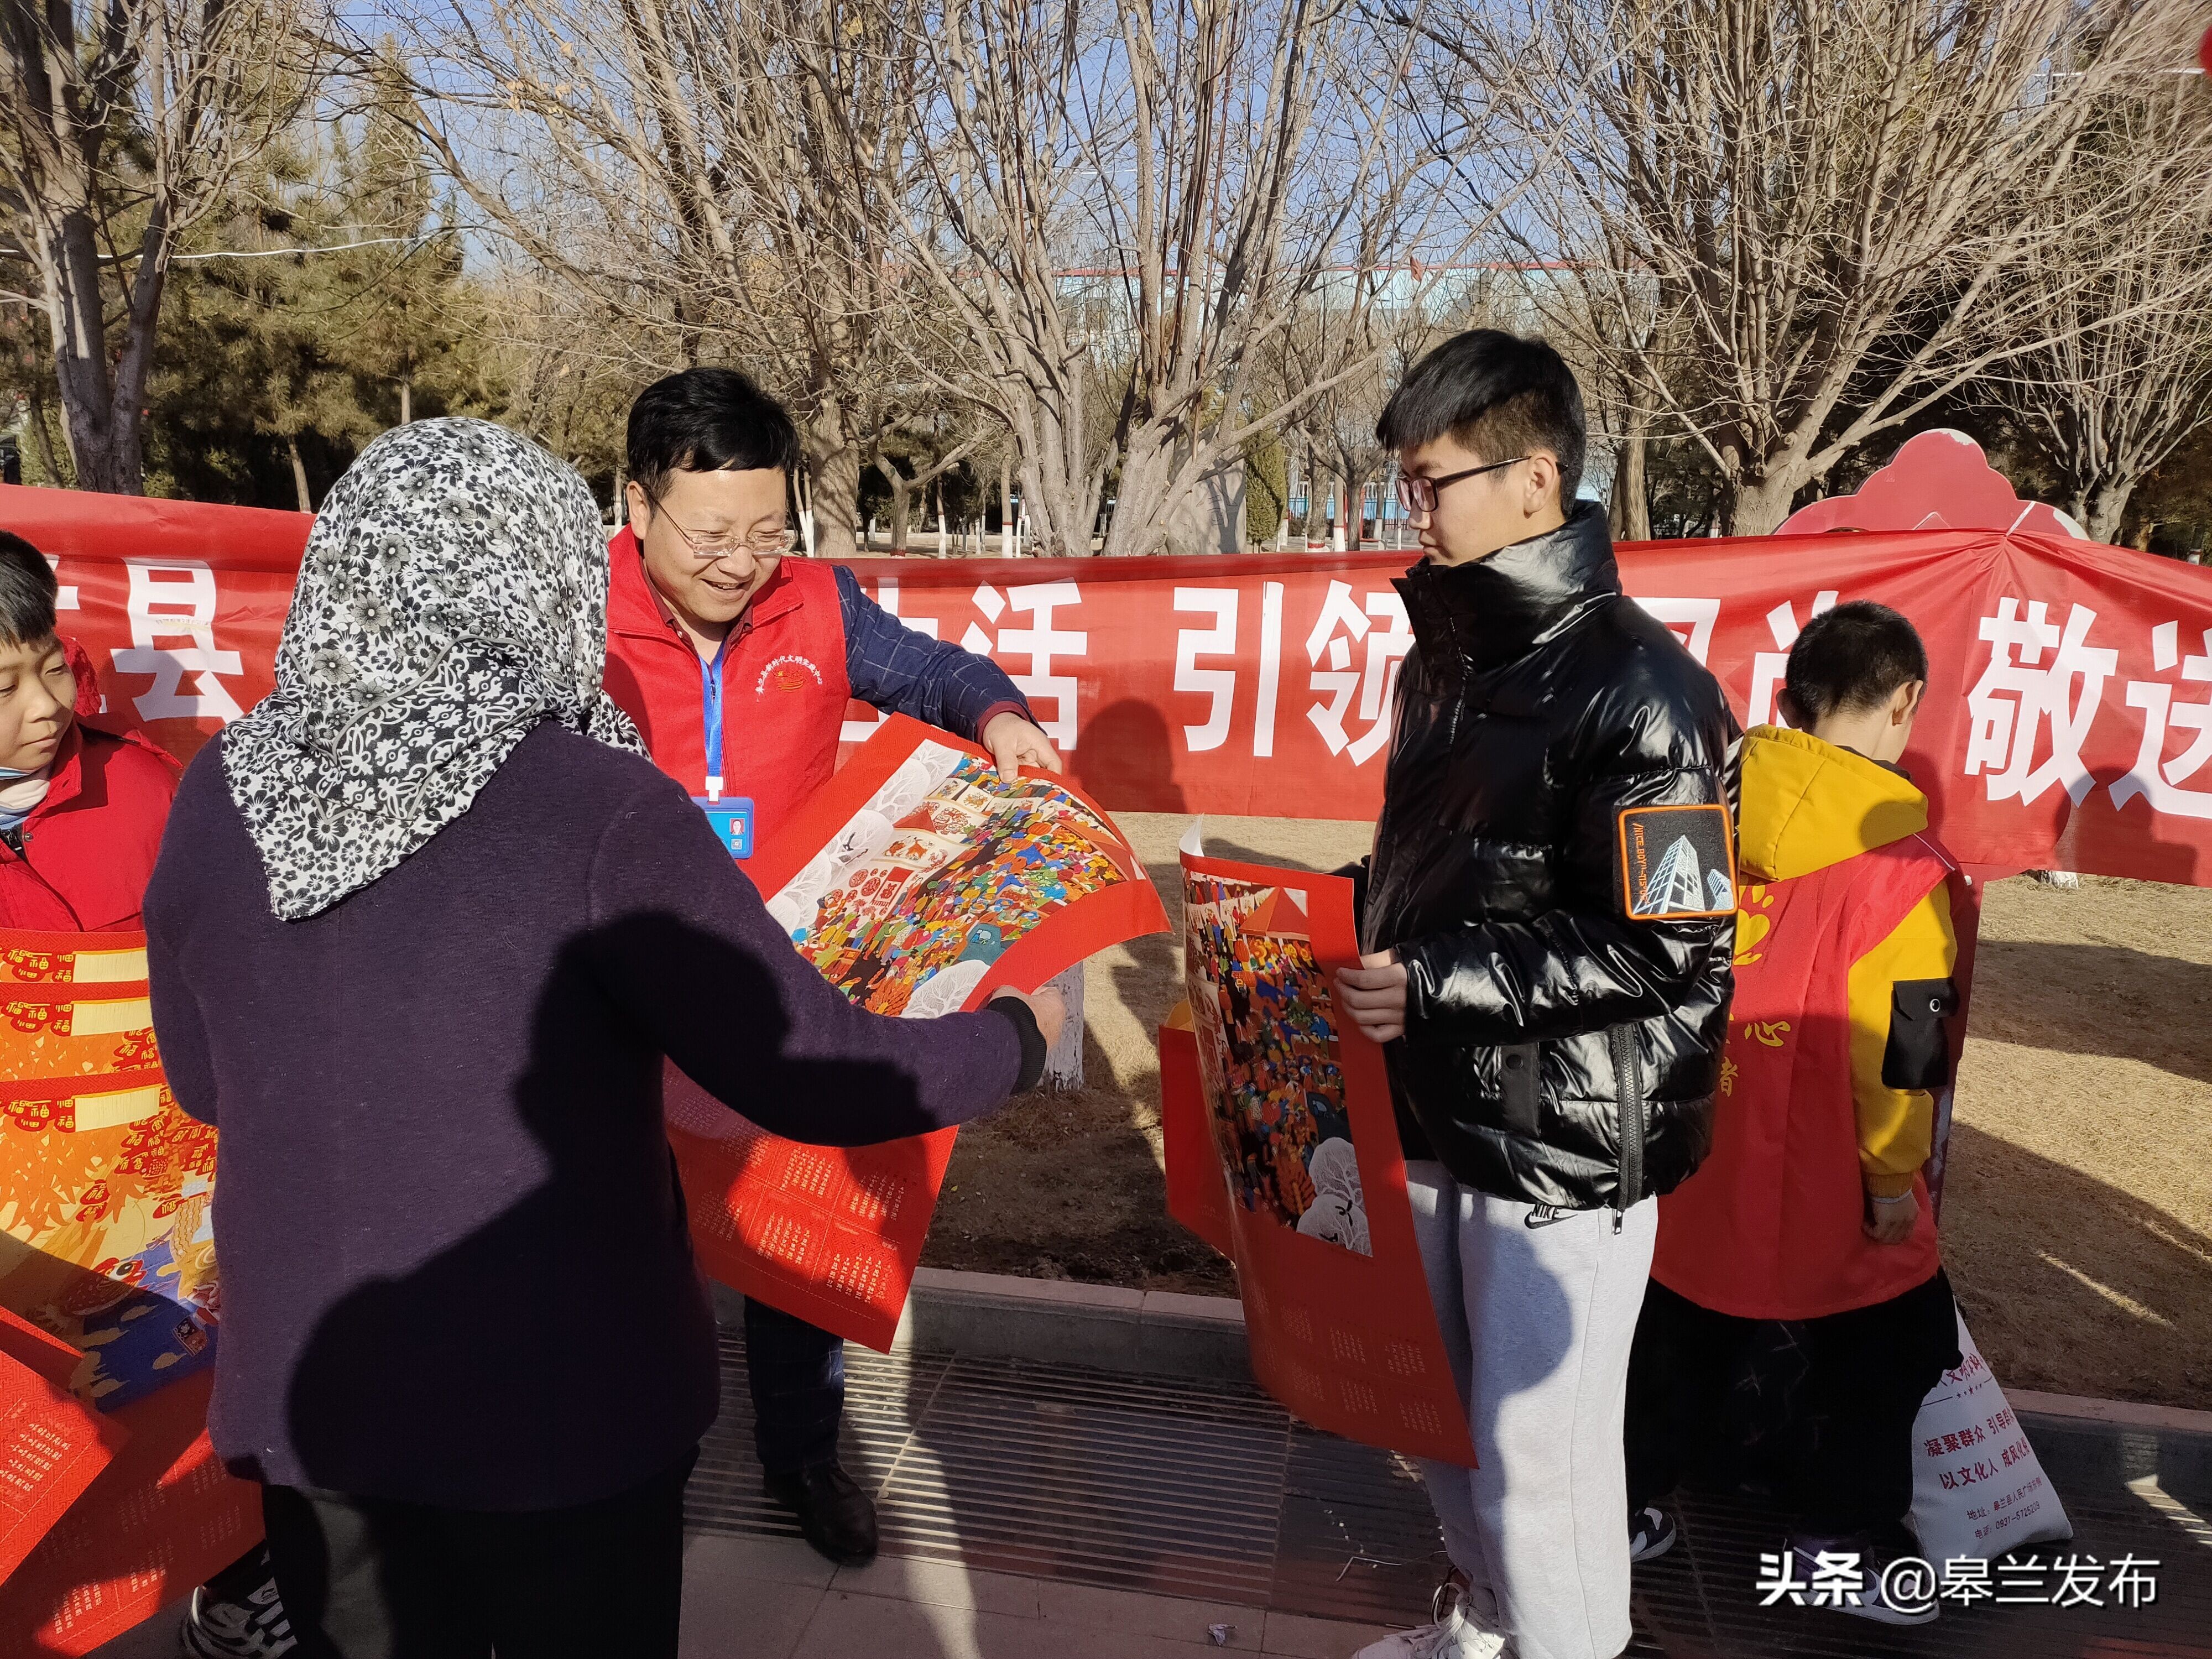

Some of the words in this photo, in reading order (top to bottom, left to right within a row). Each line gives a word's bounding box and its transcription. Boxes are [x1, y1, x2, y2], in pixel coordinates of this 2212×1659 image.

[1531, 1203, 1559, 1220] NIKE
[1924, 1424, 1986, 1458] 凝聚群众
[1939, 1458, 1999, 1490] 以文化人
